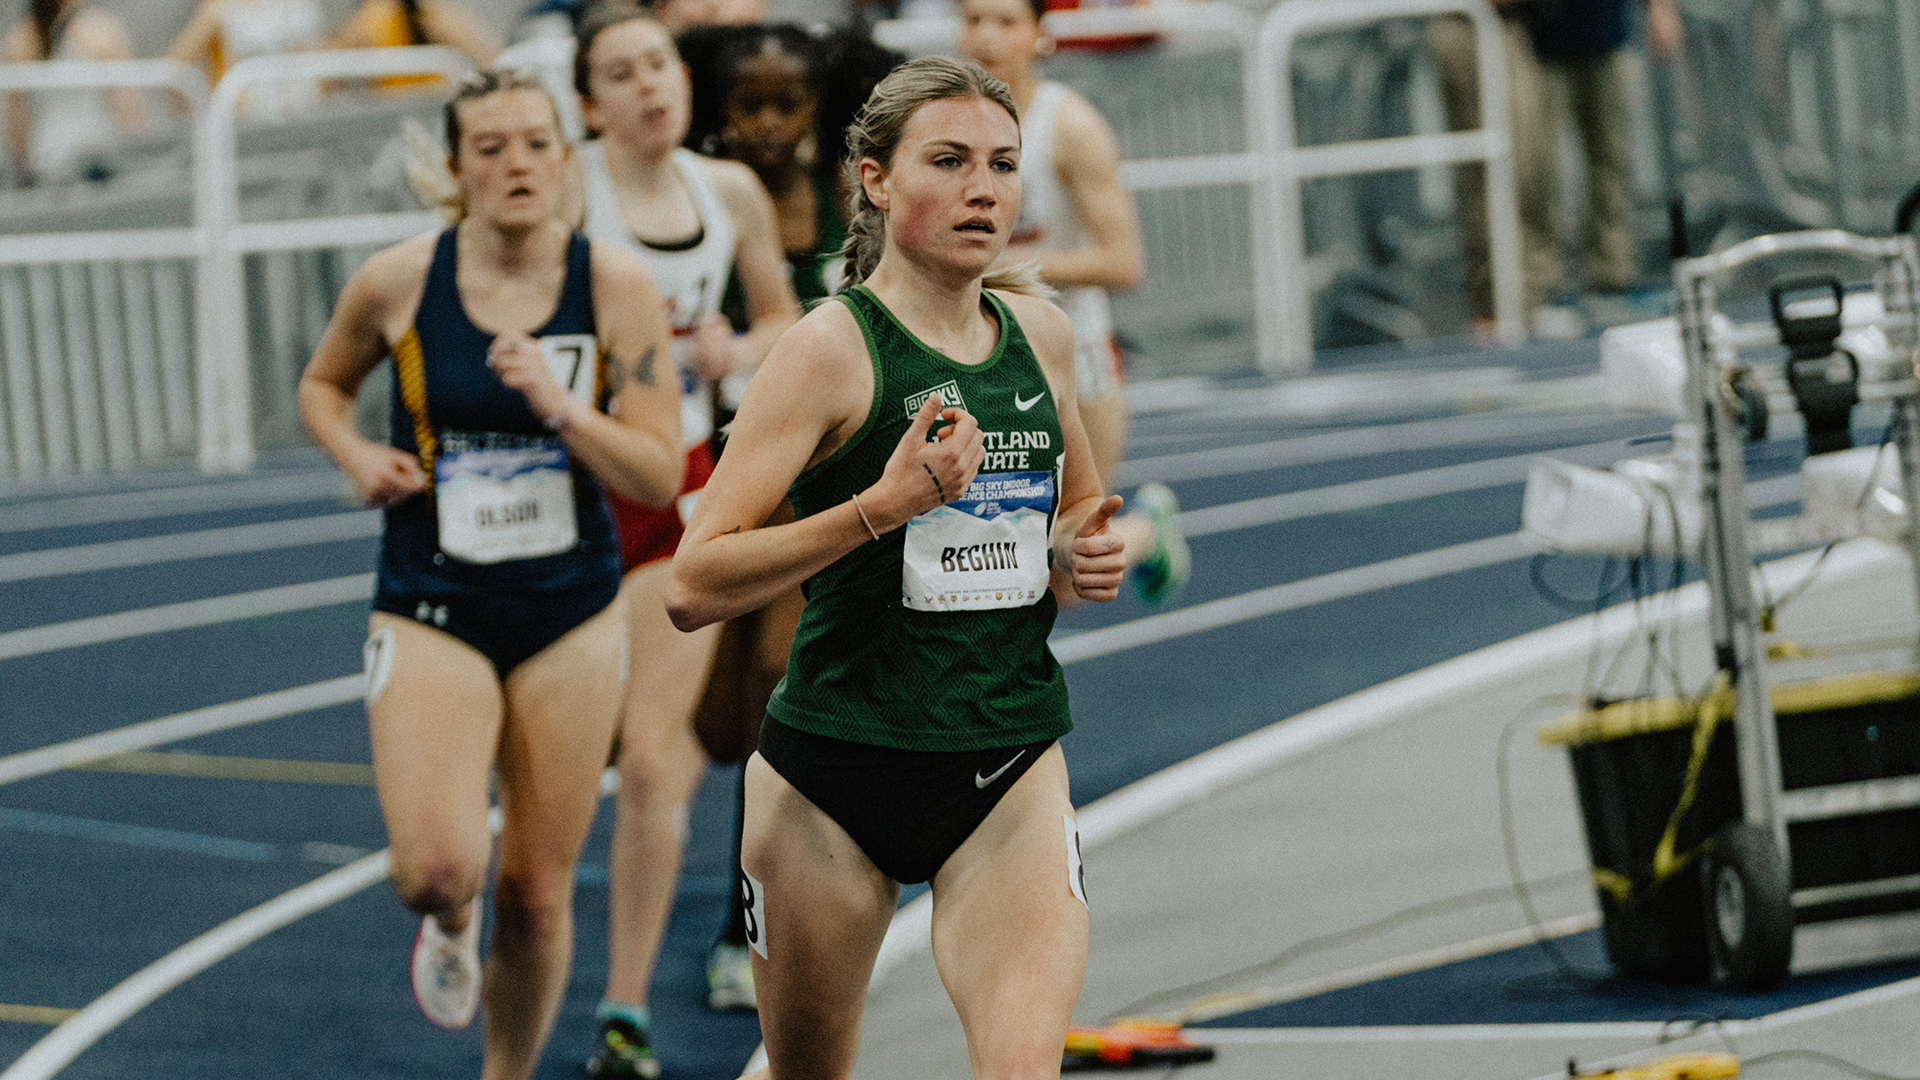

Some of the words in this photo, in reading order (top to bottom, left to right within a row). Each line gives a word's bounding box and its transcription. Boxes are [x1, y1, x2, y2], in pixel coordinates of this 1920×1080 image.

[555, 346, 583, 391] 7
[929, 385, 961, 406] KY
[982, 451, 1030, 470] TATE
[970, 482, 984, 492] BIG
[986, 481, 1002, 491] SKY
[1003, 478, 1031, 490] INDOOR
[986, 486, 1046, 500] CHAMPIONSHIP
[940, 541, 1019, 573] BEGHIN
